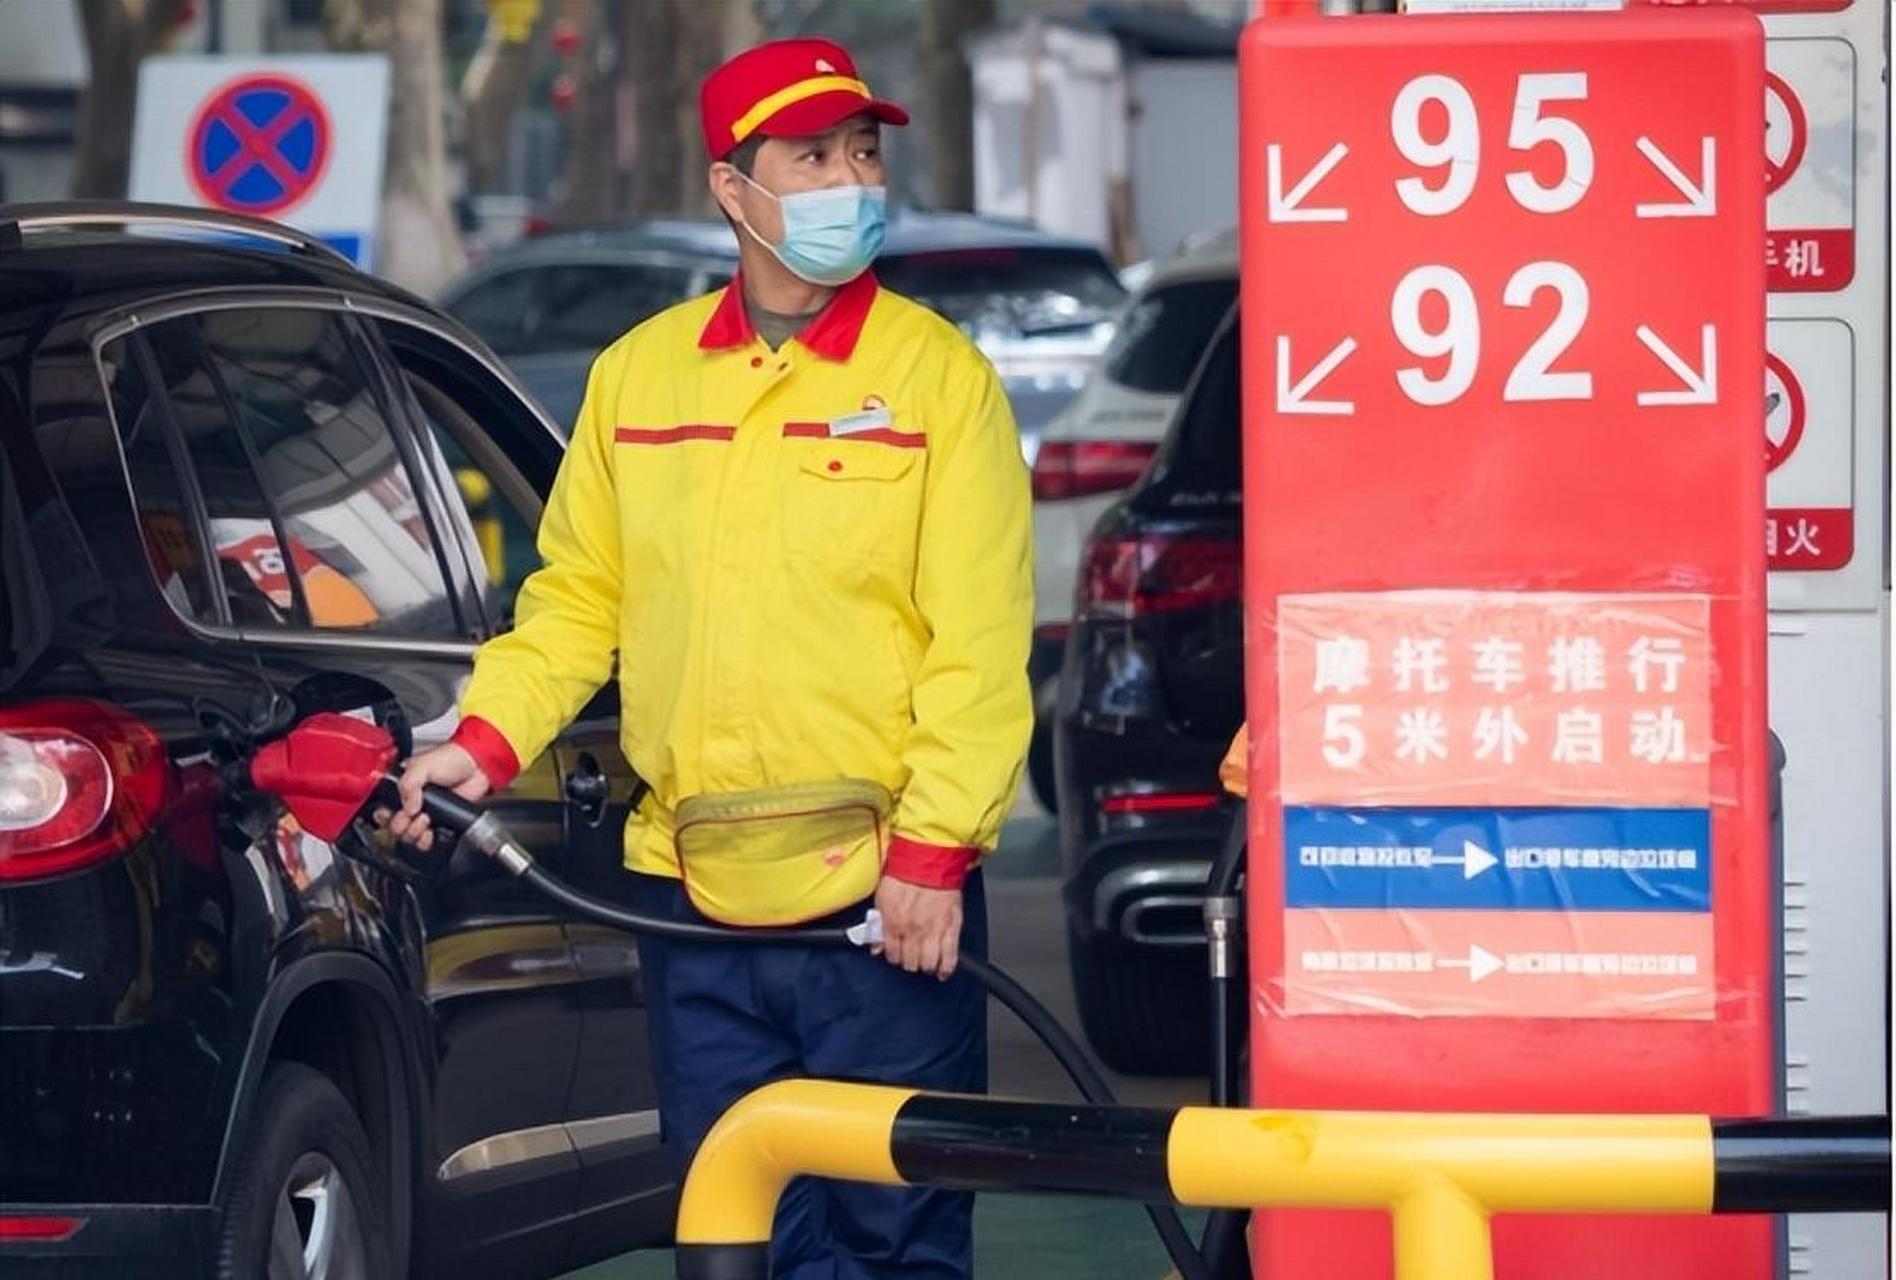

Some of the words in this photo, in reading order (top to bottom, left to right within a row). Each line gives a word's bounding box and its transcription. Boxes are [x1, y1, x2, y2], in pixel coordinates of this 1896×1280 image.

[1390, 71, 1595, 217] 95
[1390, 260, 1594, 406] 92
[1313, 635, 1686, 695] 摩托车推行
[1321, 703, 1687, 768] 5米外启动
